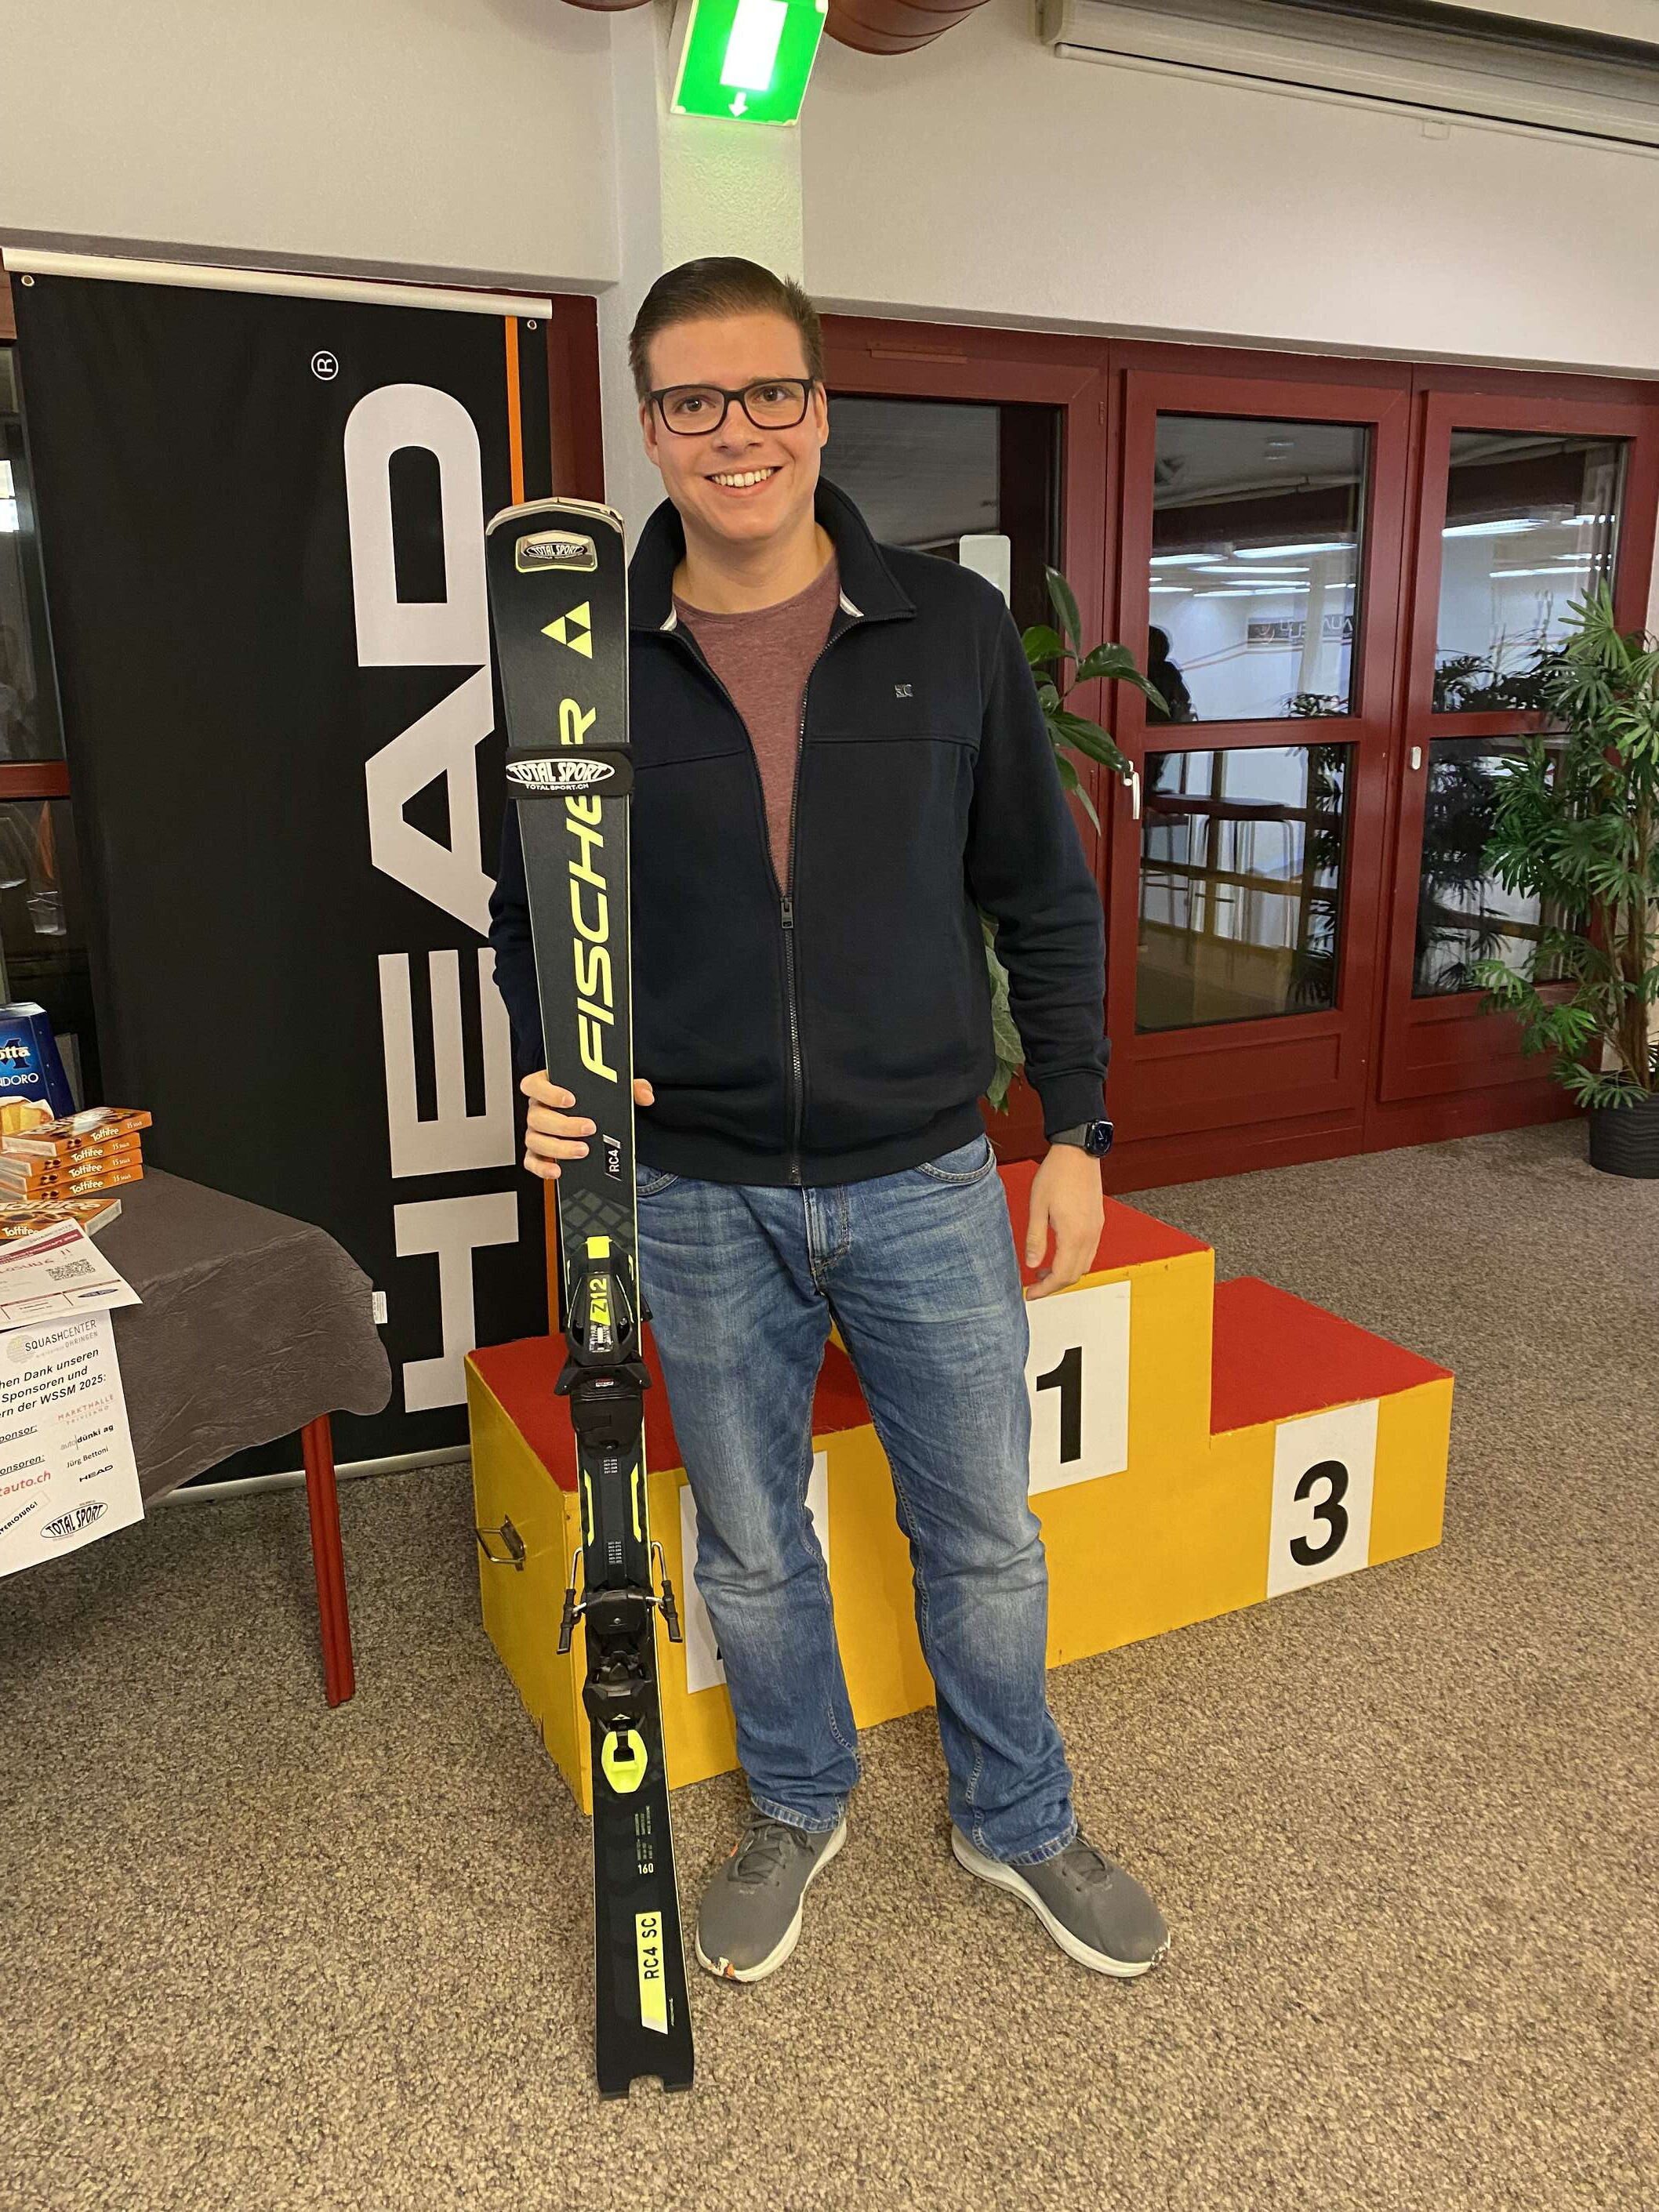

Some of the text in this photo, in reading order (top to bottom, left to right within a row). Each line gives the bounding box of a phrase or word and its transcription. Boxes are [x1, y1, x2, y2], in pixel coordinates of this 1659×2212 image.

[531, 544, 580, 556] TOTAL SPORT
[510, 762, 607, 782] TOTAL SPORT
[344, 383, 519, 1412] HEAD
[559, 698, 618, 1083] FISCHER
[90, 1127, 119, 1142] Toffifee
[71, 1148, 103, 1162] Toffifee
[609, 1149, 620, 1173] RC4
[68, 1163, 103, 1178] Toffifee
[69, 1180, 103, 1194] Toffifee
[589, 1278, 608, 1314] Z12
[25, 1319, 97, 1352] SQUASHCENTER
[24, 1365, 53, 1381] Dank
[56, 1349, 99, 1370] unseren
[0, 1374, 107, 1417] rn der WSSM 2025:
[2, 1365, 88, 1403] Sponsoren und
[57, 1394, 114, 1421] MARKTHALLE
[1036, 1346, 1083, 1464] 1
[67, 1445, 108, 1468] Jürg Bettoni
[79, 1464, 114, 1482] HEAD
[45, 1505, 103, 1536] TOTAL SPORT
[1290, 1460, 1349, 1566] 3
[637, 1862, 654, 1875] 160
[641, 1917, 659, 1979] RC4 SC
